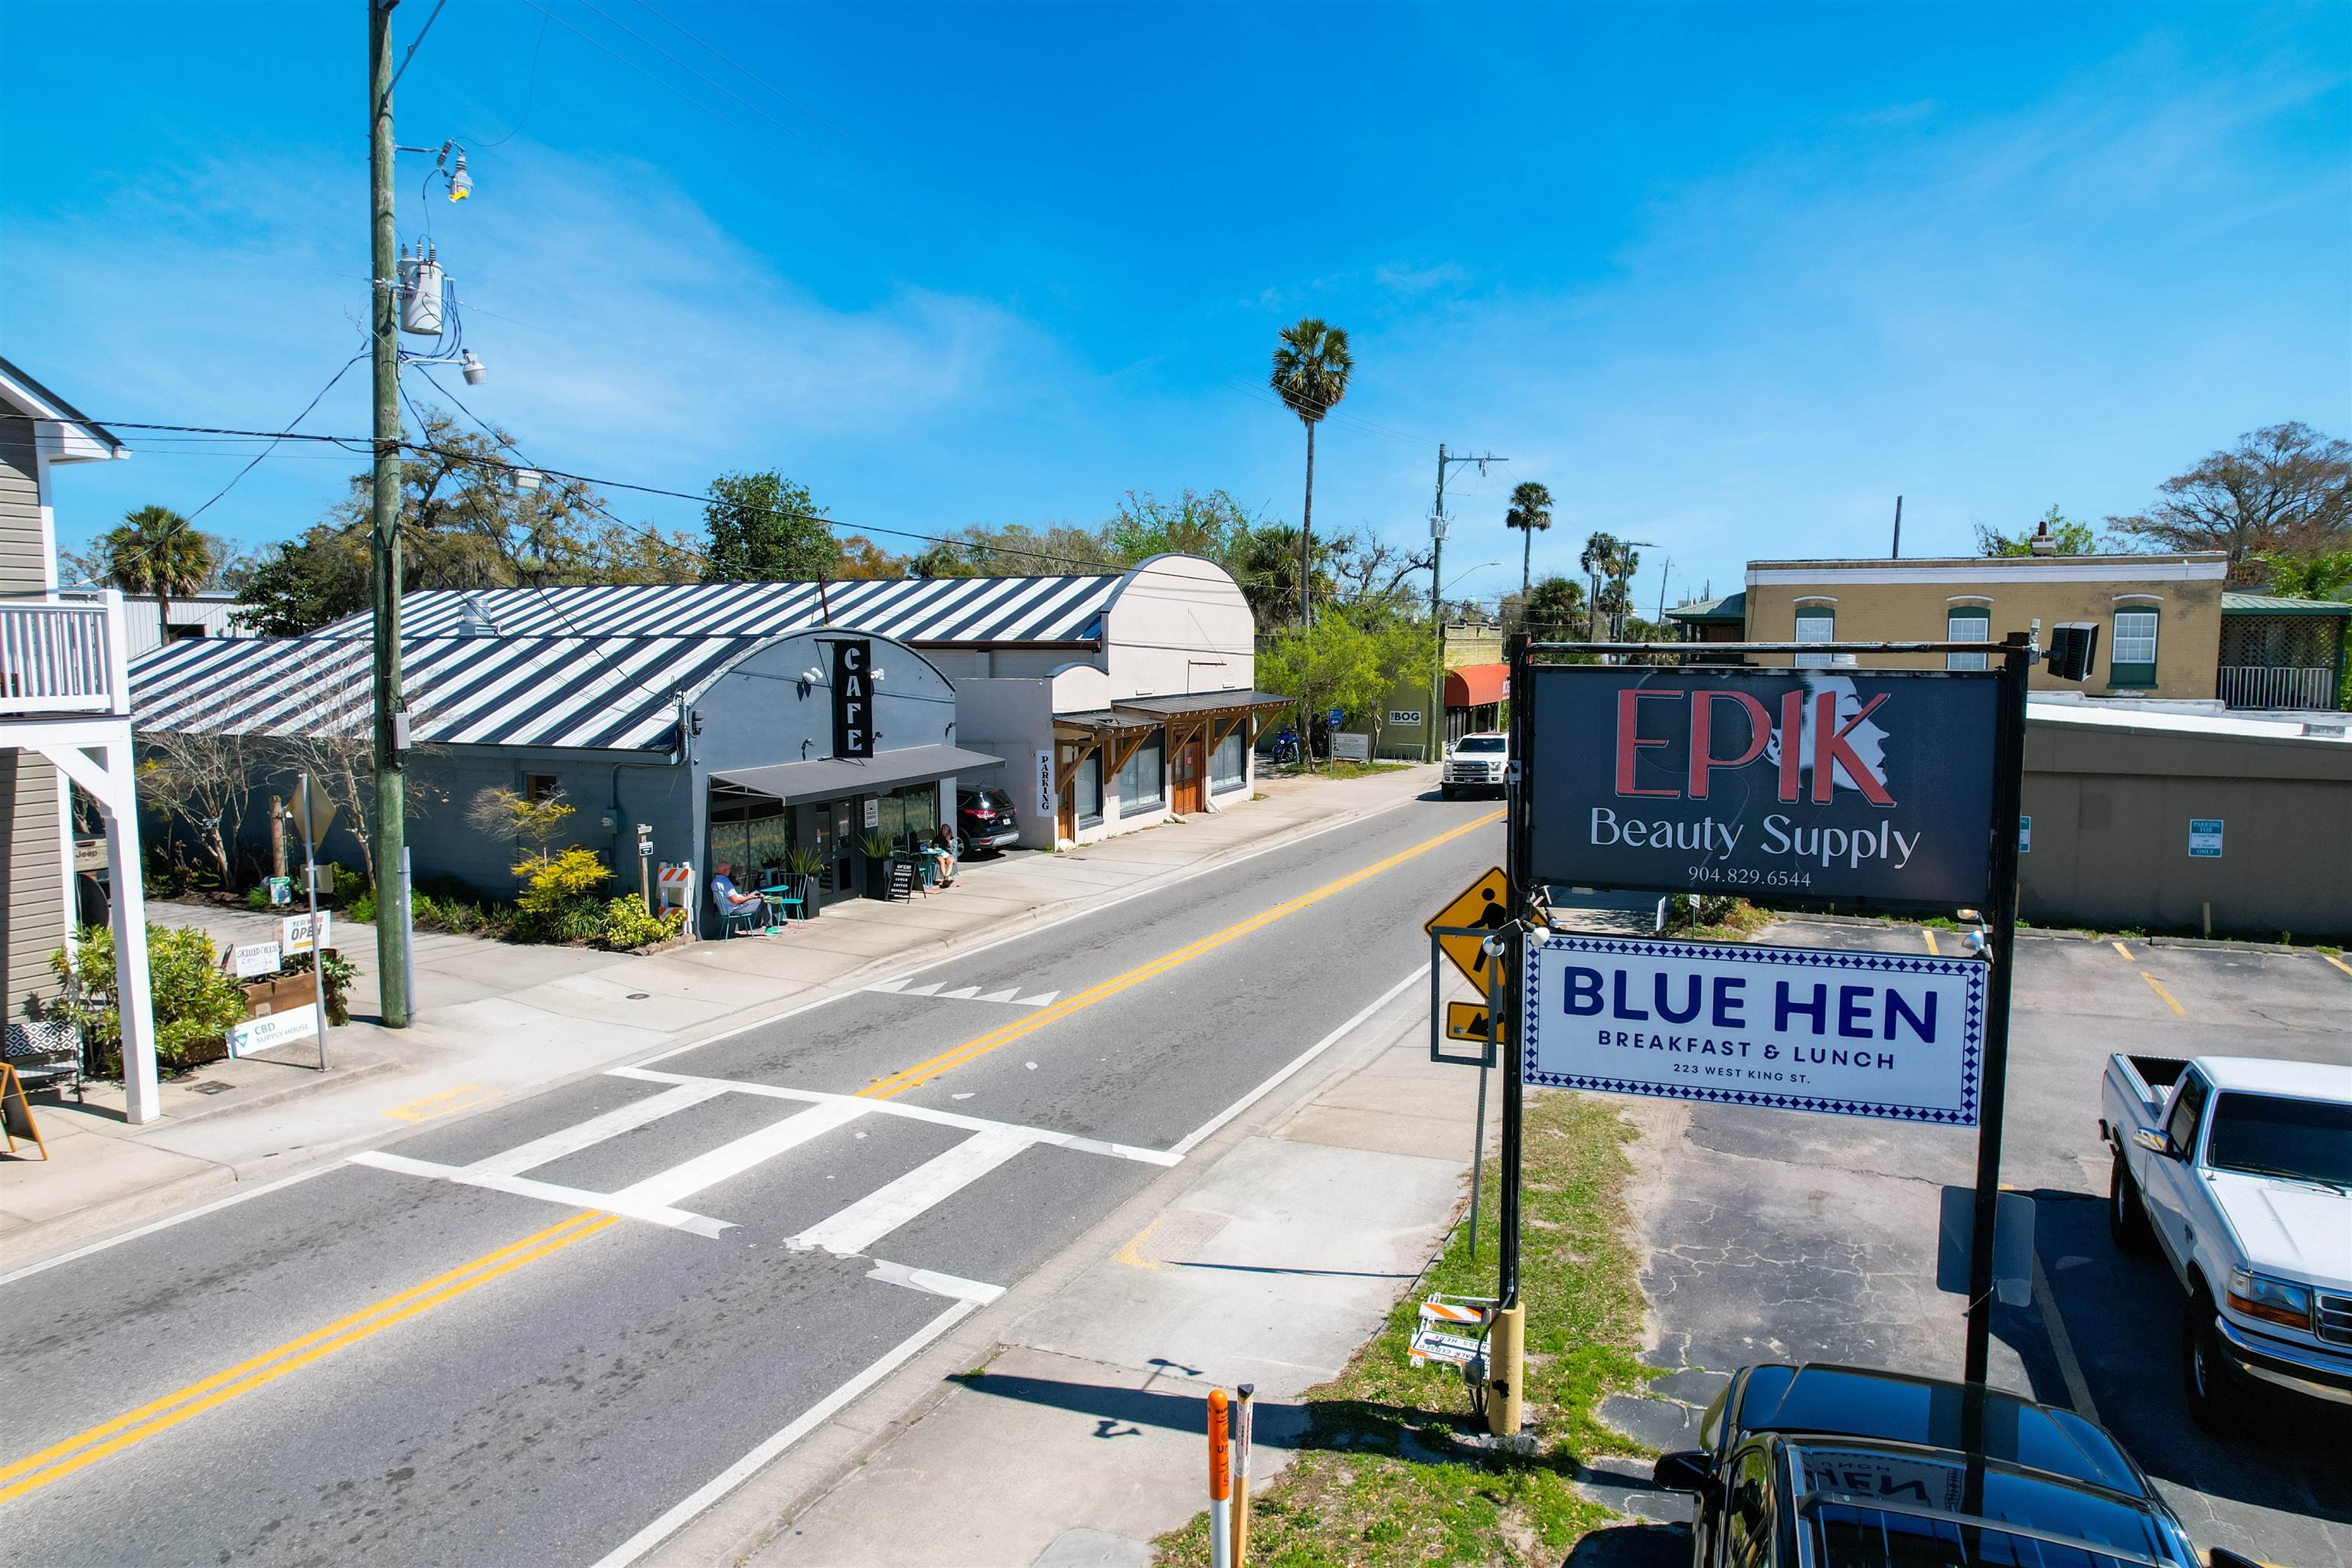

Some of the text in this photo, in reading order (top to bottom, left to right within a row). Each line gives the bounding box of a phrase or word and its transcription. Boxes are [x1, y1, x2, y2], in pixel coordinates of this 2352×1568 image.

[844, 648, 862, 750] CAFE
[1394, 712, 1420, 720] BOG
[1615, 690, 1897, 808] EPIK
[1041, 756, 1050, 810] PARKING
[1590, 807, 1922, 869] Beauty Supply
[75, 850, 98, 858] Jeep
[1688, 866, 1811, 887] 904.829.6544
[237, 947, 260, 959] GRILLED
[1564, 965, 1938, 1044] BLUE HEN
[255, 1022, 276, 1035] CBD
[256, 1023, 310, 1044] SUPPLY HOUSE
[1598, 1030, 1894, 1070] BREAKFAST & LUNCH
[1673, 1063, 1811, 1084] 223 WEST KING ST.
